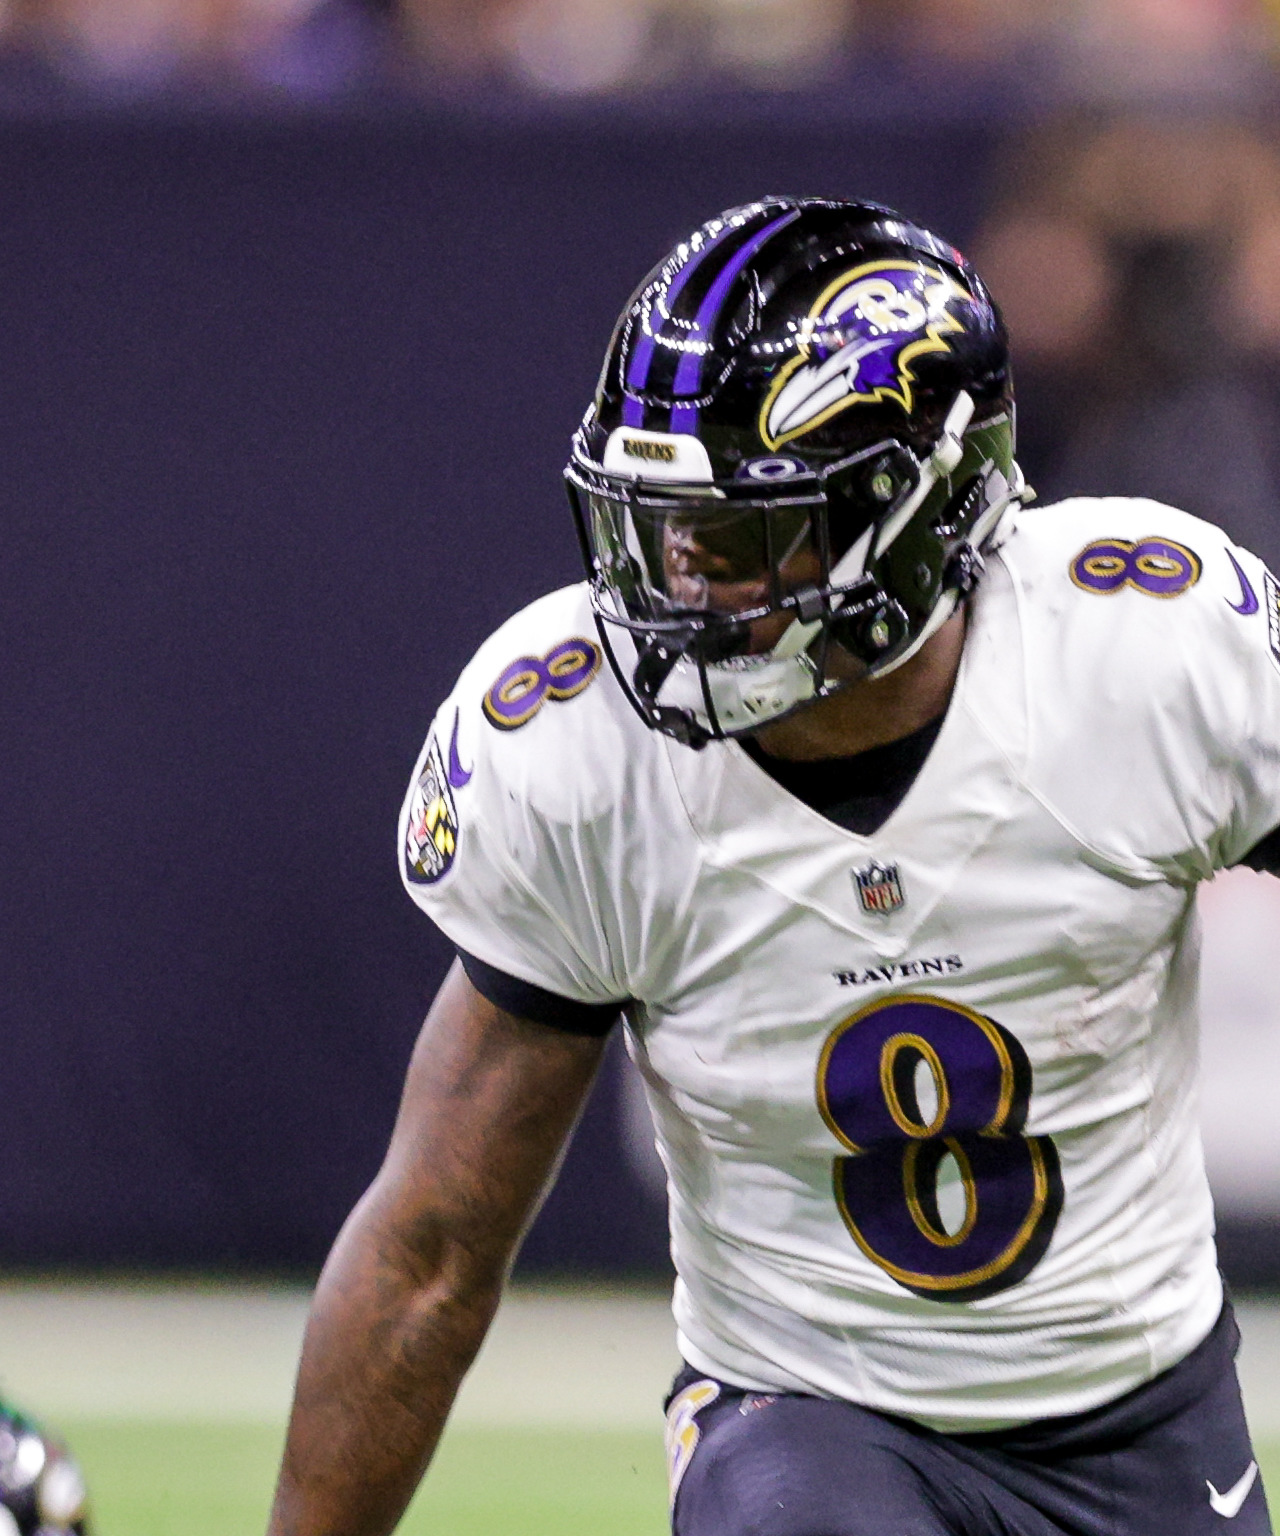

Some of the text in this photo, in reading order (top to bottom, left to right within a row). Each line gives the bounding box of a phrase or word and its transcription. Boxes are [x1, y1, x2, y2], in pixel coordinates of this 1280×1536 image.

[1069, 536, 1203, 599] 8
[481, 636, 602, 731] 8
[832, 954, 963, 986] RAVENS
[816, 993, 1064, 1302] 8
